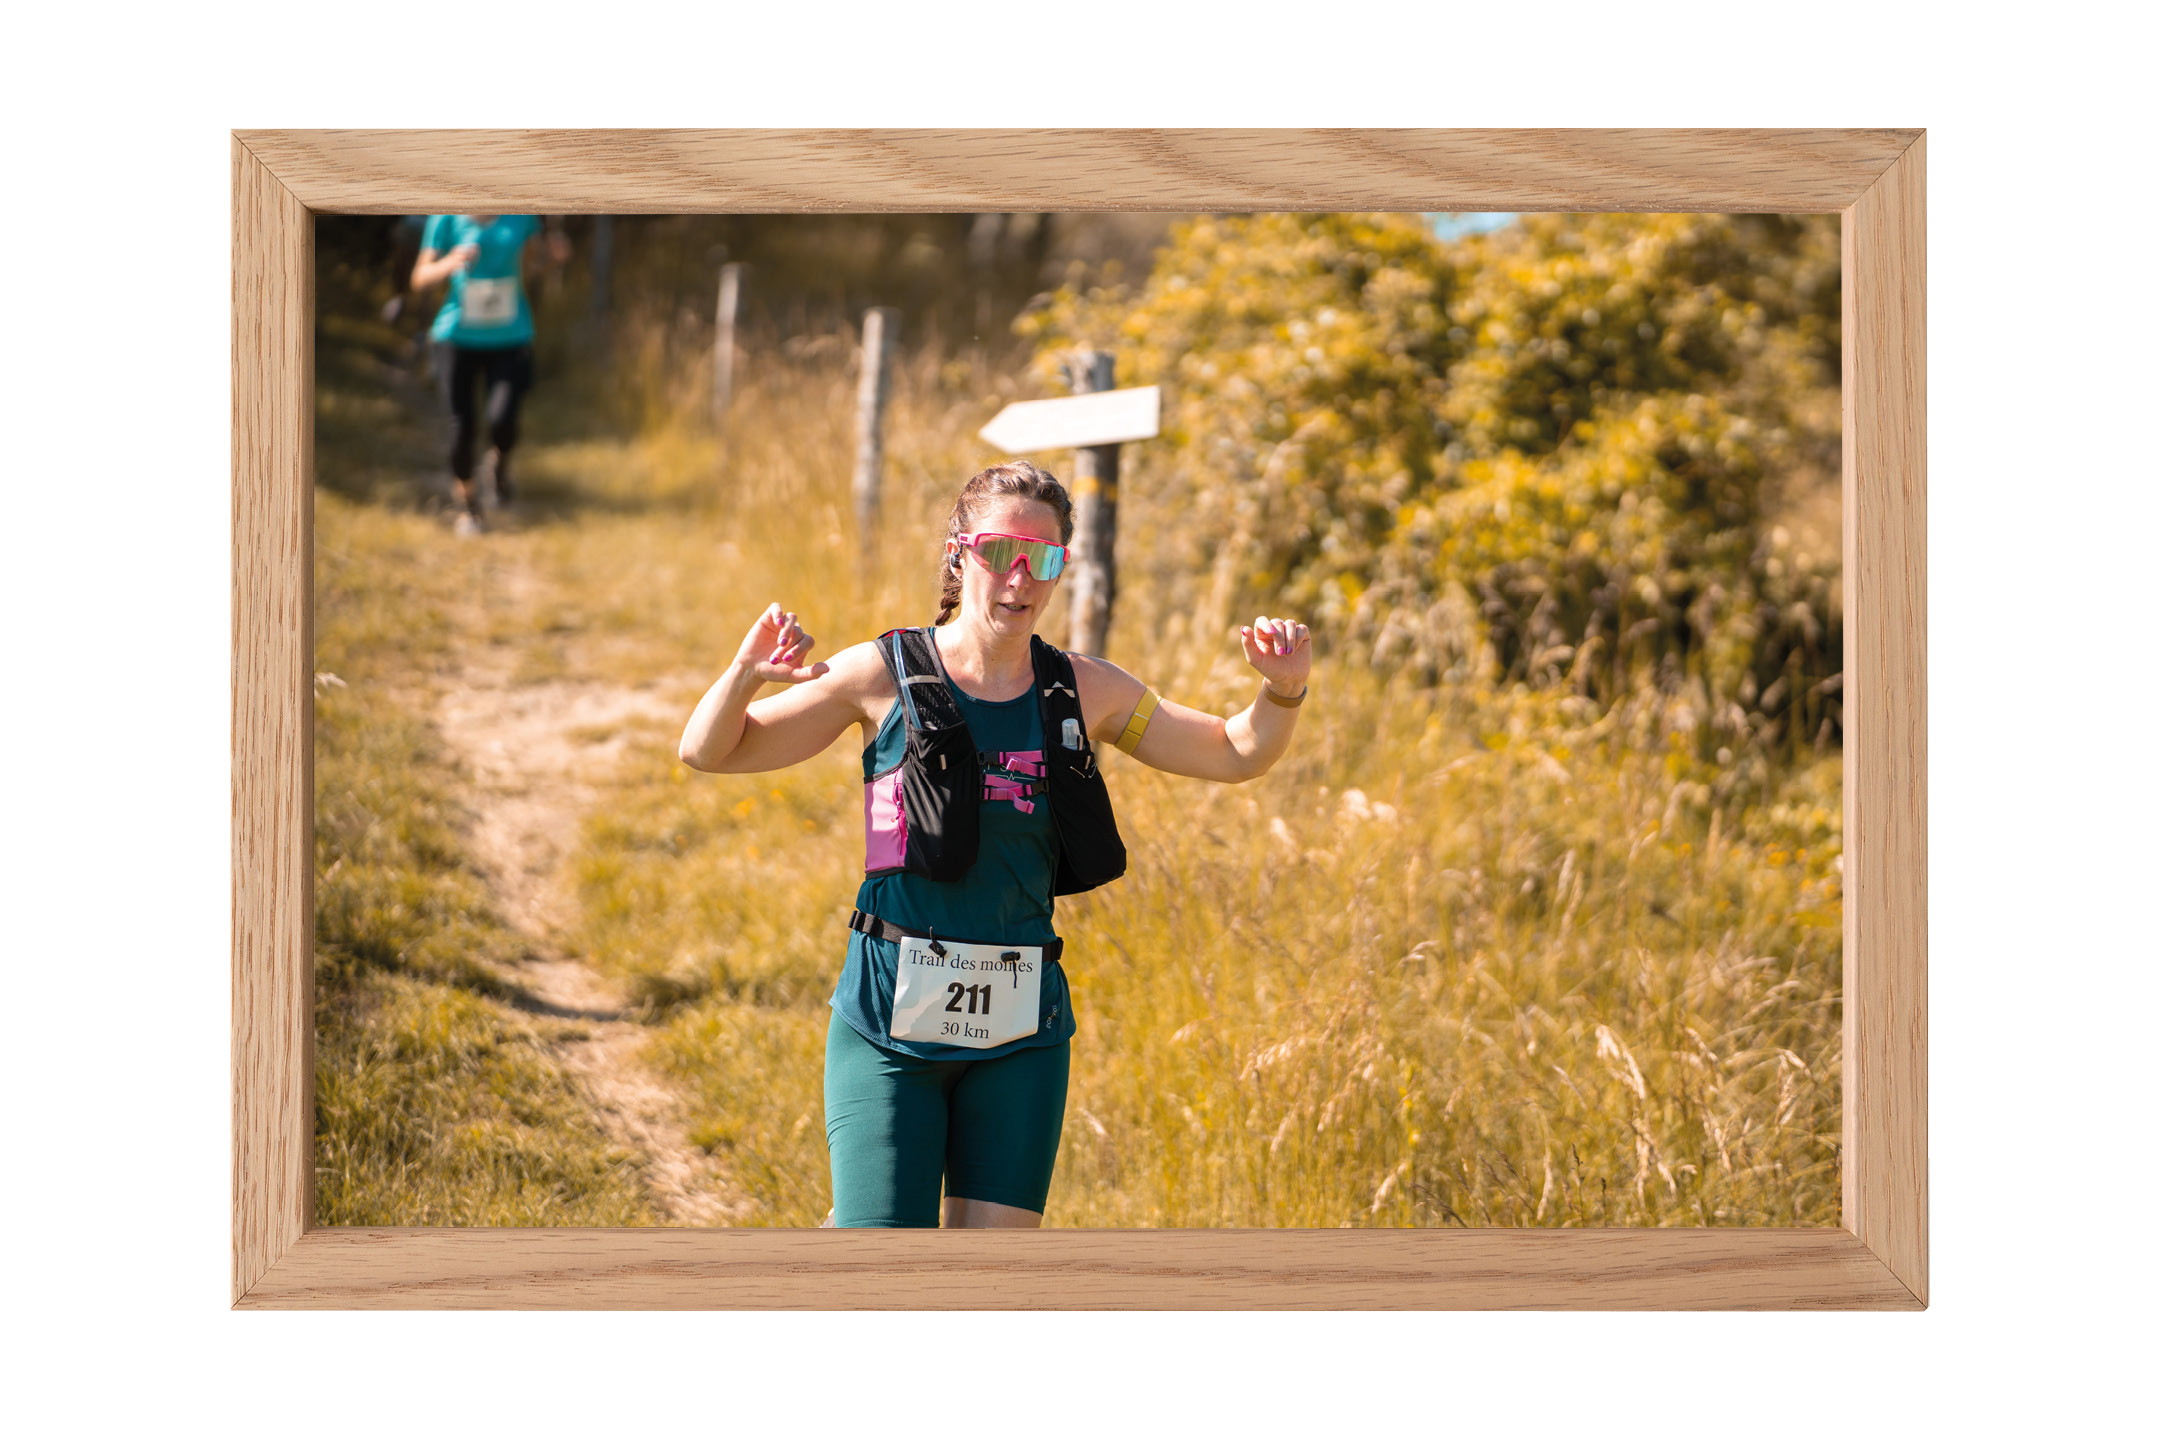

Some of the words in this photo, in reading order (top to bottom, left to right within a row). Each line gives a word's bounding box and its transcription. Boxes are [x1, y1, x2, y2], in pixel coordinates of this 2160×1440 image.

[950, 953, 977, 971] des
[945, 982, 992, 1015] 211
[940, 1021, 960, 1036] 30
[963, 1022, 990, 1039] km
